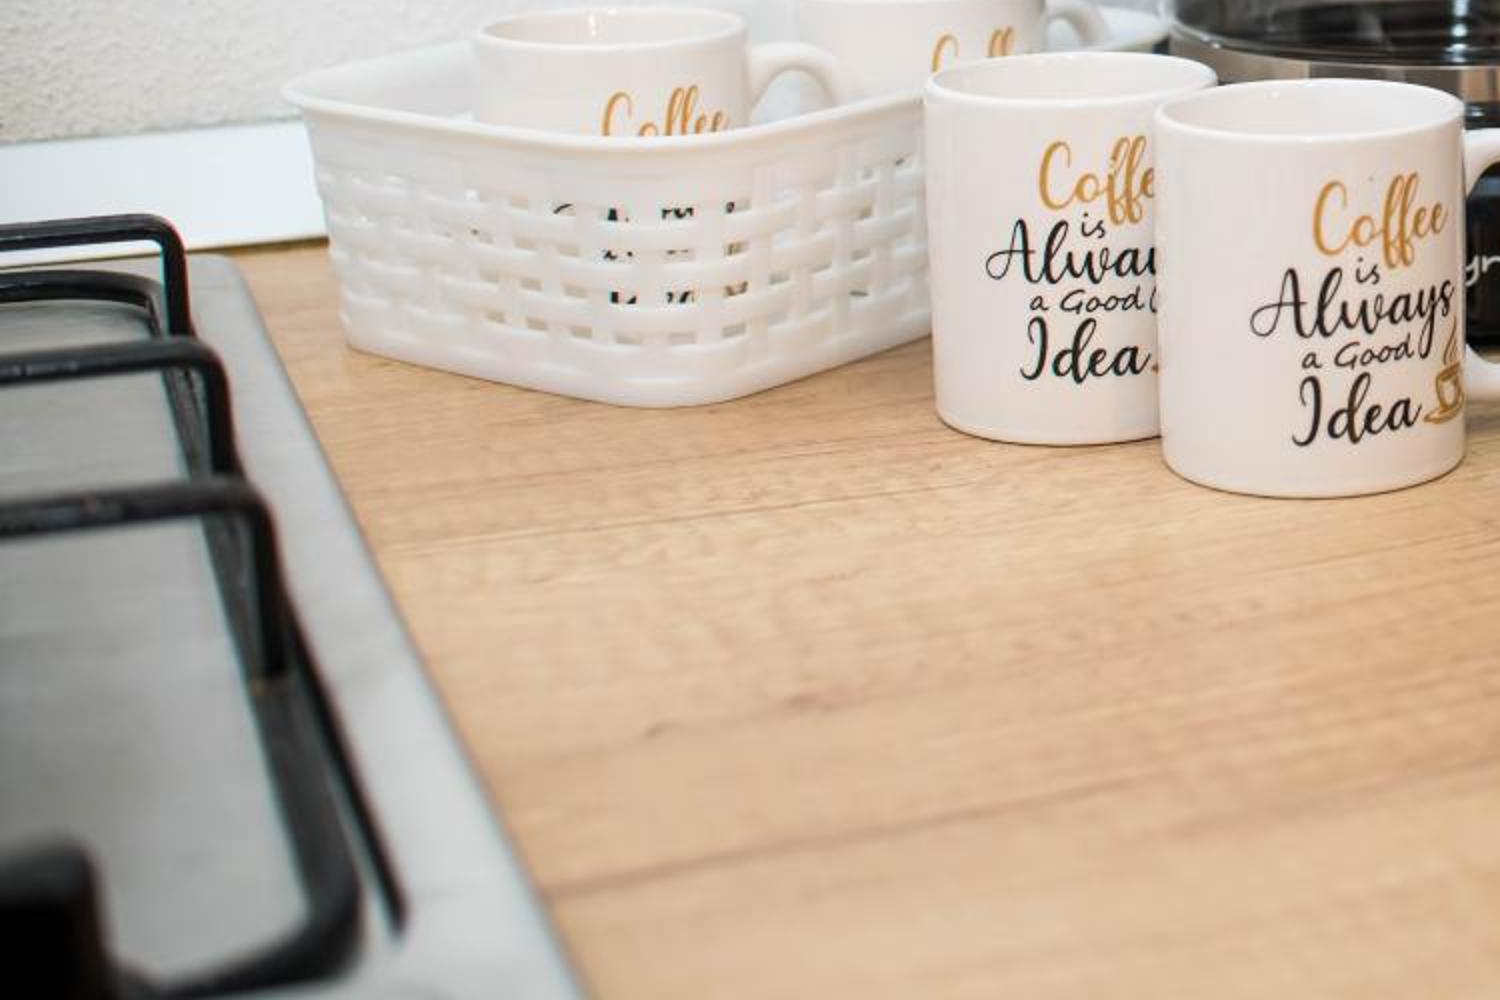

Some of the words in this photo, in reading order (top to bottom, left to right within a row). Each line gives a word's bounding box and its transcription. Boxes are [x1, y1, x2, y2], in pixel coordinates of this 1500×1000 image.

[1039, 135, 1154, 225] Coffe
[1081, 212, 1107, 239] is
[1312, 171, 1449, 270] Coffee
[985, 218, 1157, 313] Alwa
[1029, 296, 1049, 312] a
[1060, 285, 1146, 315] Good
[1355, 256, 1381, 285] is
[1249, 266, 1455, 359] Always
[1020, 316, 1152, 385] Idea
[1301, 352, 1323, 370] a
[1333, 332, 1415, 370] Good
[1291, 371, 1423, 447] Idea
